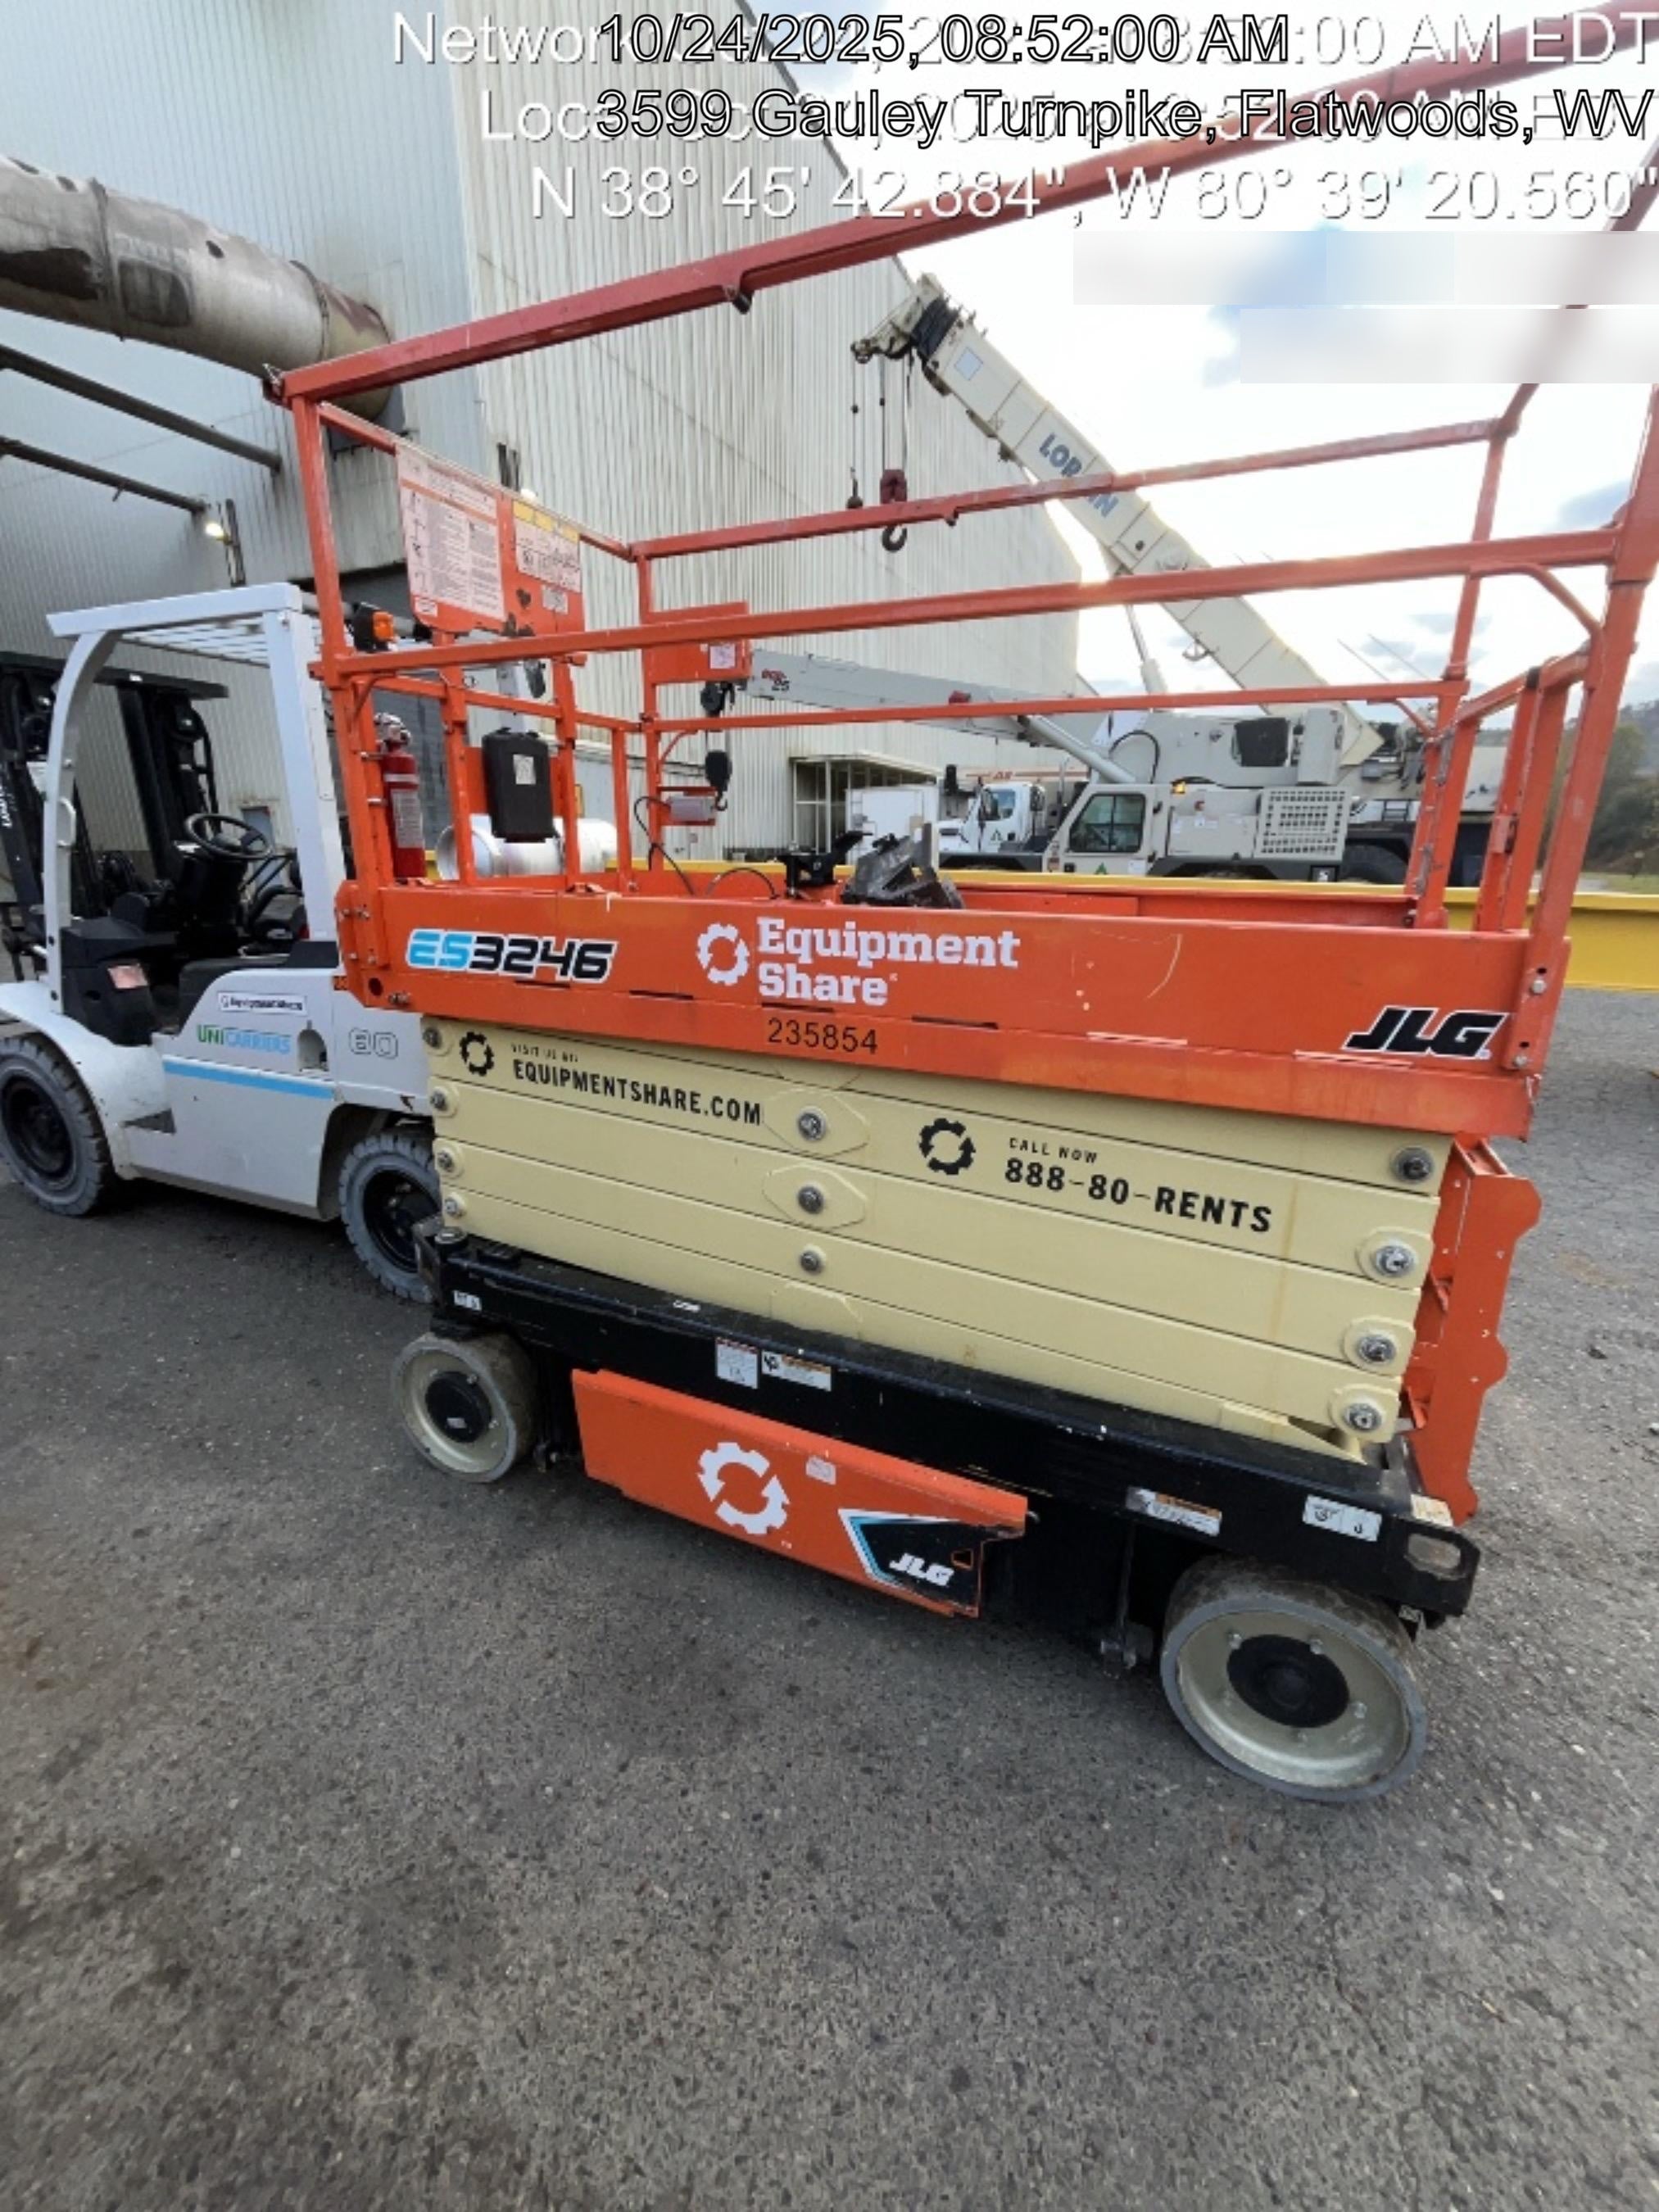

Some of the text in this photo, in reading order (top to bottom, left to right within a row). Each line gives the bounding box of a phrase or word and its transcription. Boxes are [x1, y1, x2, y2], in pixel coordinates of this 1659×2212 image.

[406, 928, 619, 983] ES3246
[756, 917, 1021, 968] Equipment
[757, 962, 889, 1007] Share
[767, 1018, 879, 1055] 235854
[1340, 1004, 1510, 1059] JLG
[512, 1058, 762, 1126] EQUIPMENTSHARE.COM
[1009, 1137, 1098, 1165] CALL NOW
[1004, 1157, 1272, 1233] 888-80-RENTS
[889, 1552, 954, 1587] JLG
